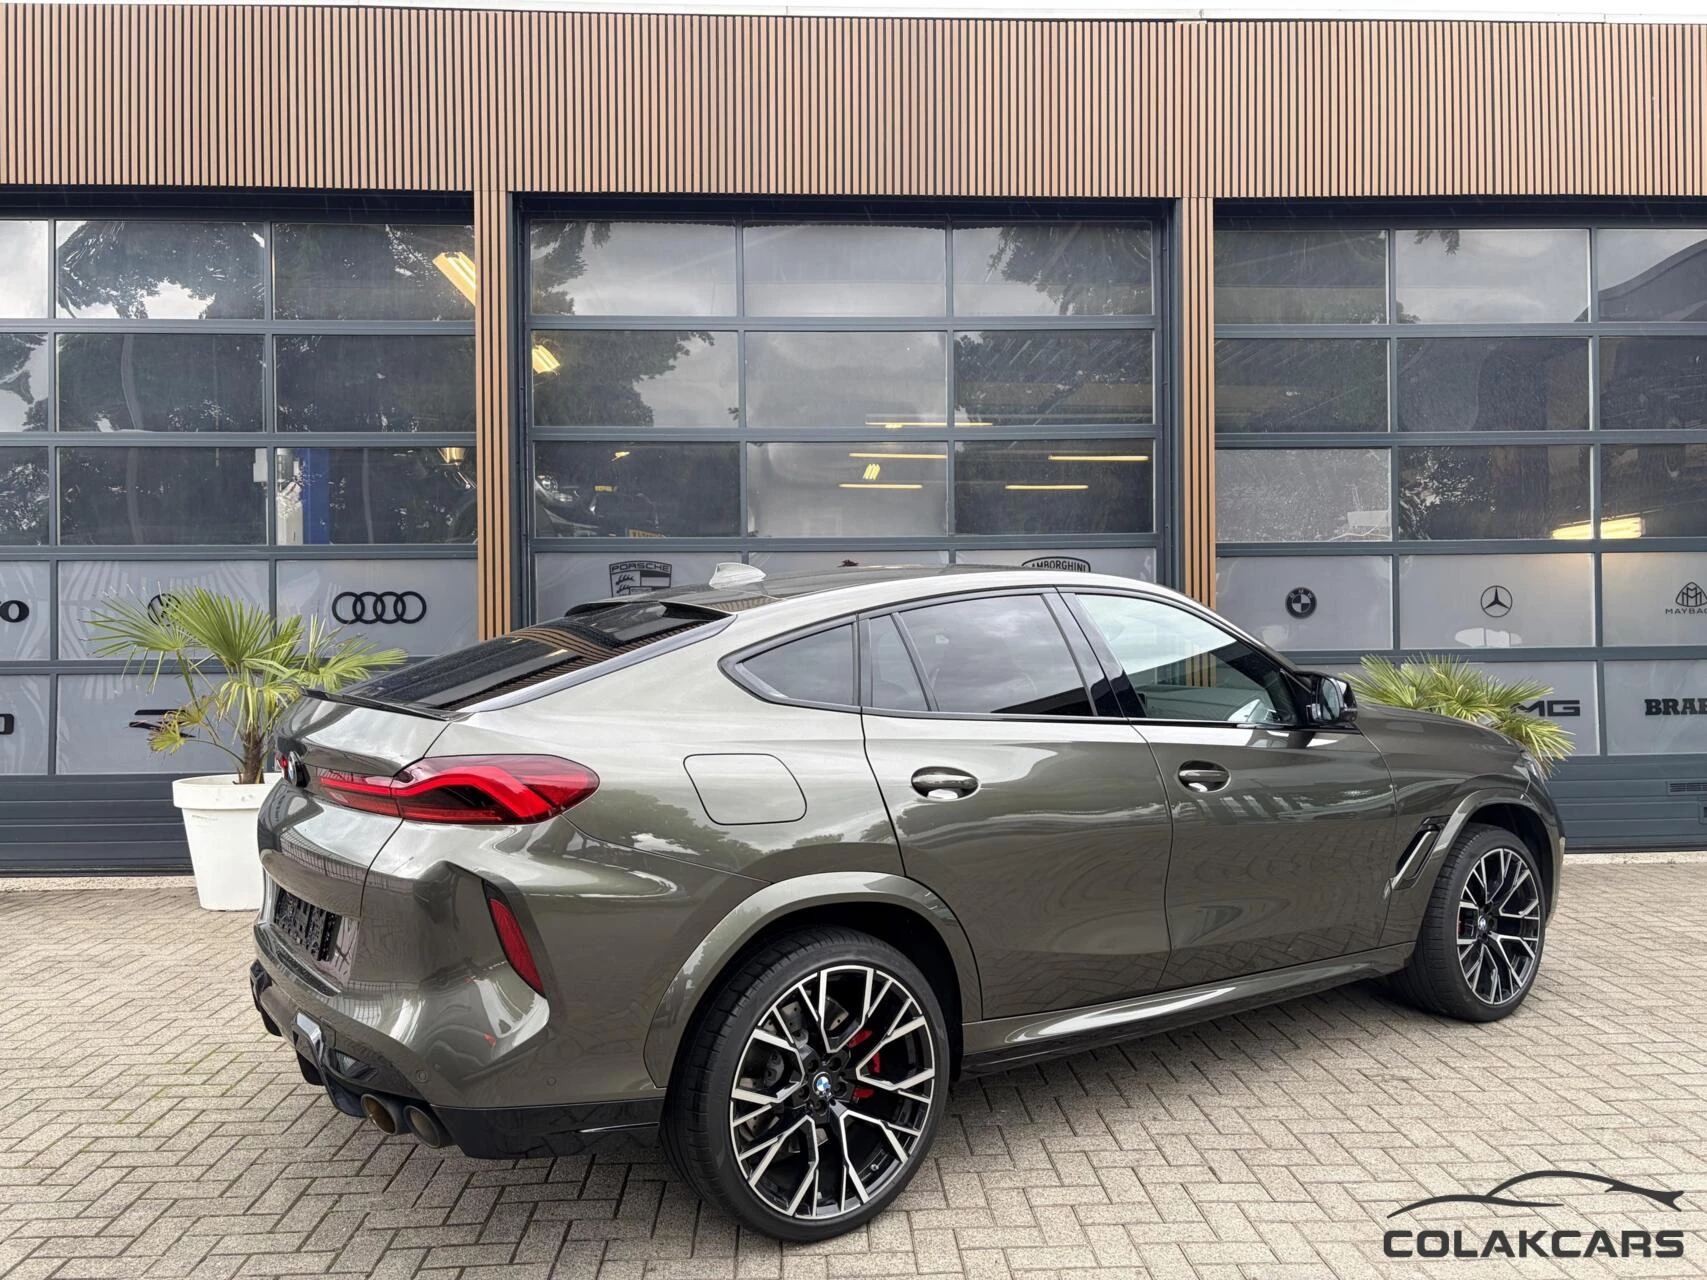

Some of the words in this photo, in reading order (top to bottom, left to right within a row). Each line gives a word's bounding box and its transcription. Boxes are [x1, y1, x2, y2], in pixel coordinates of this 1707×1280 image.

[611, 562, 670, 573] PORSCHE
[1031, 560, 1087, 573] MBORGHINI
[1510, 700, 1581, 717] MG
